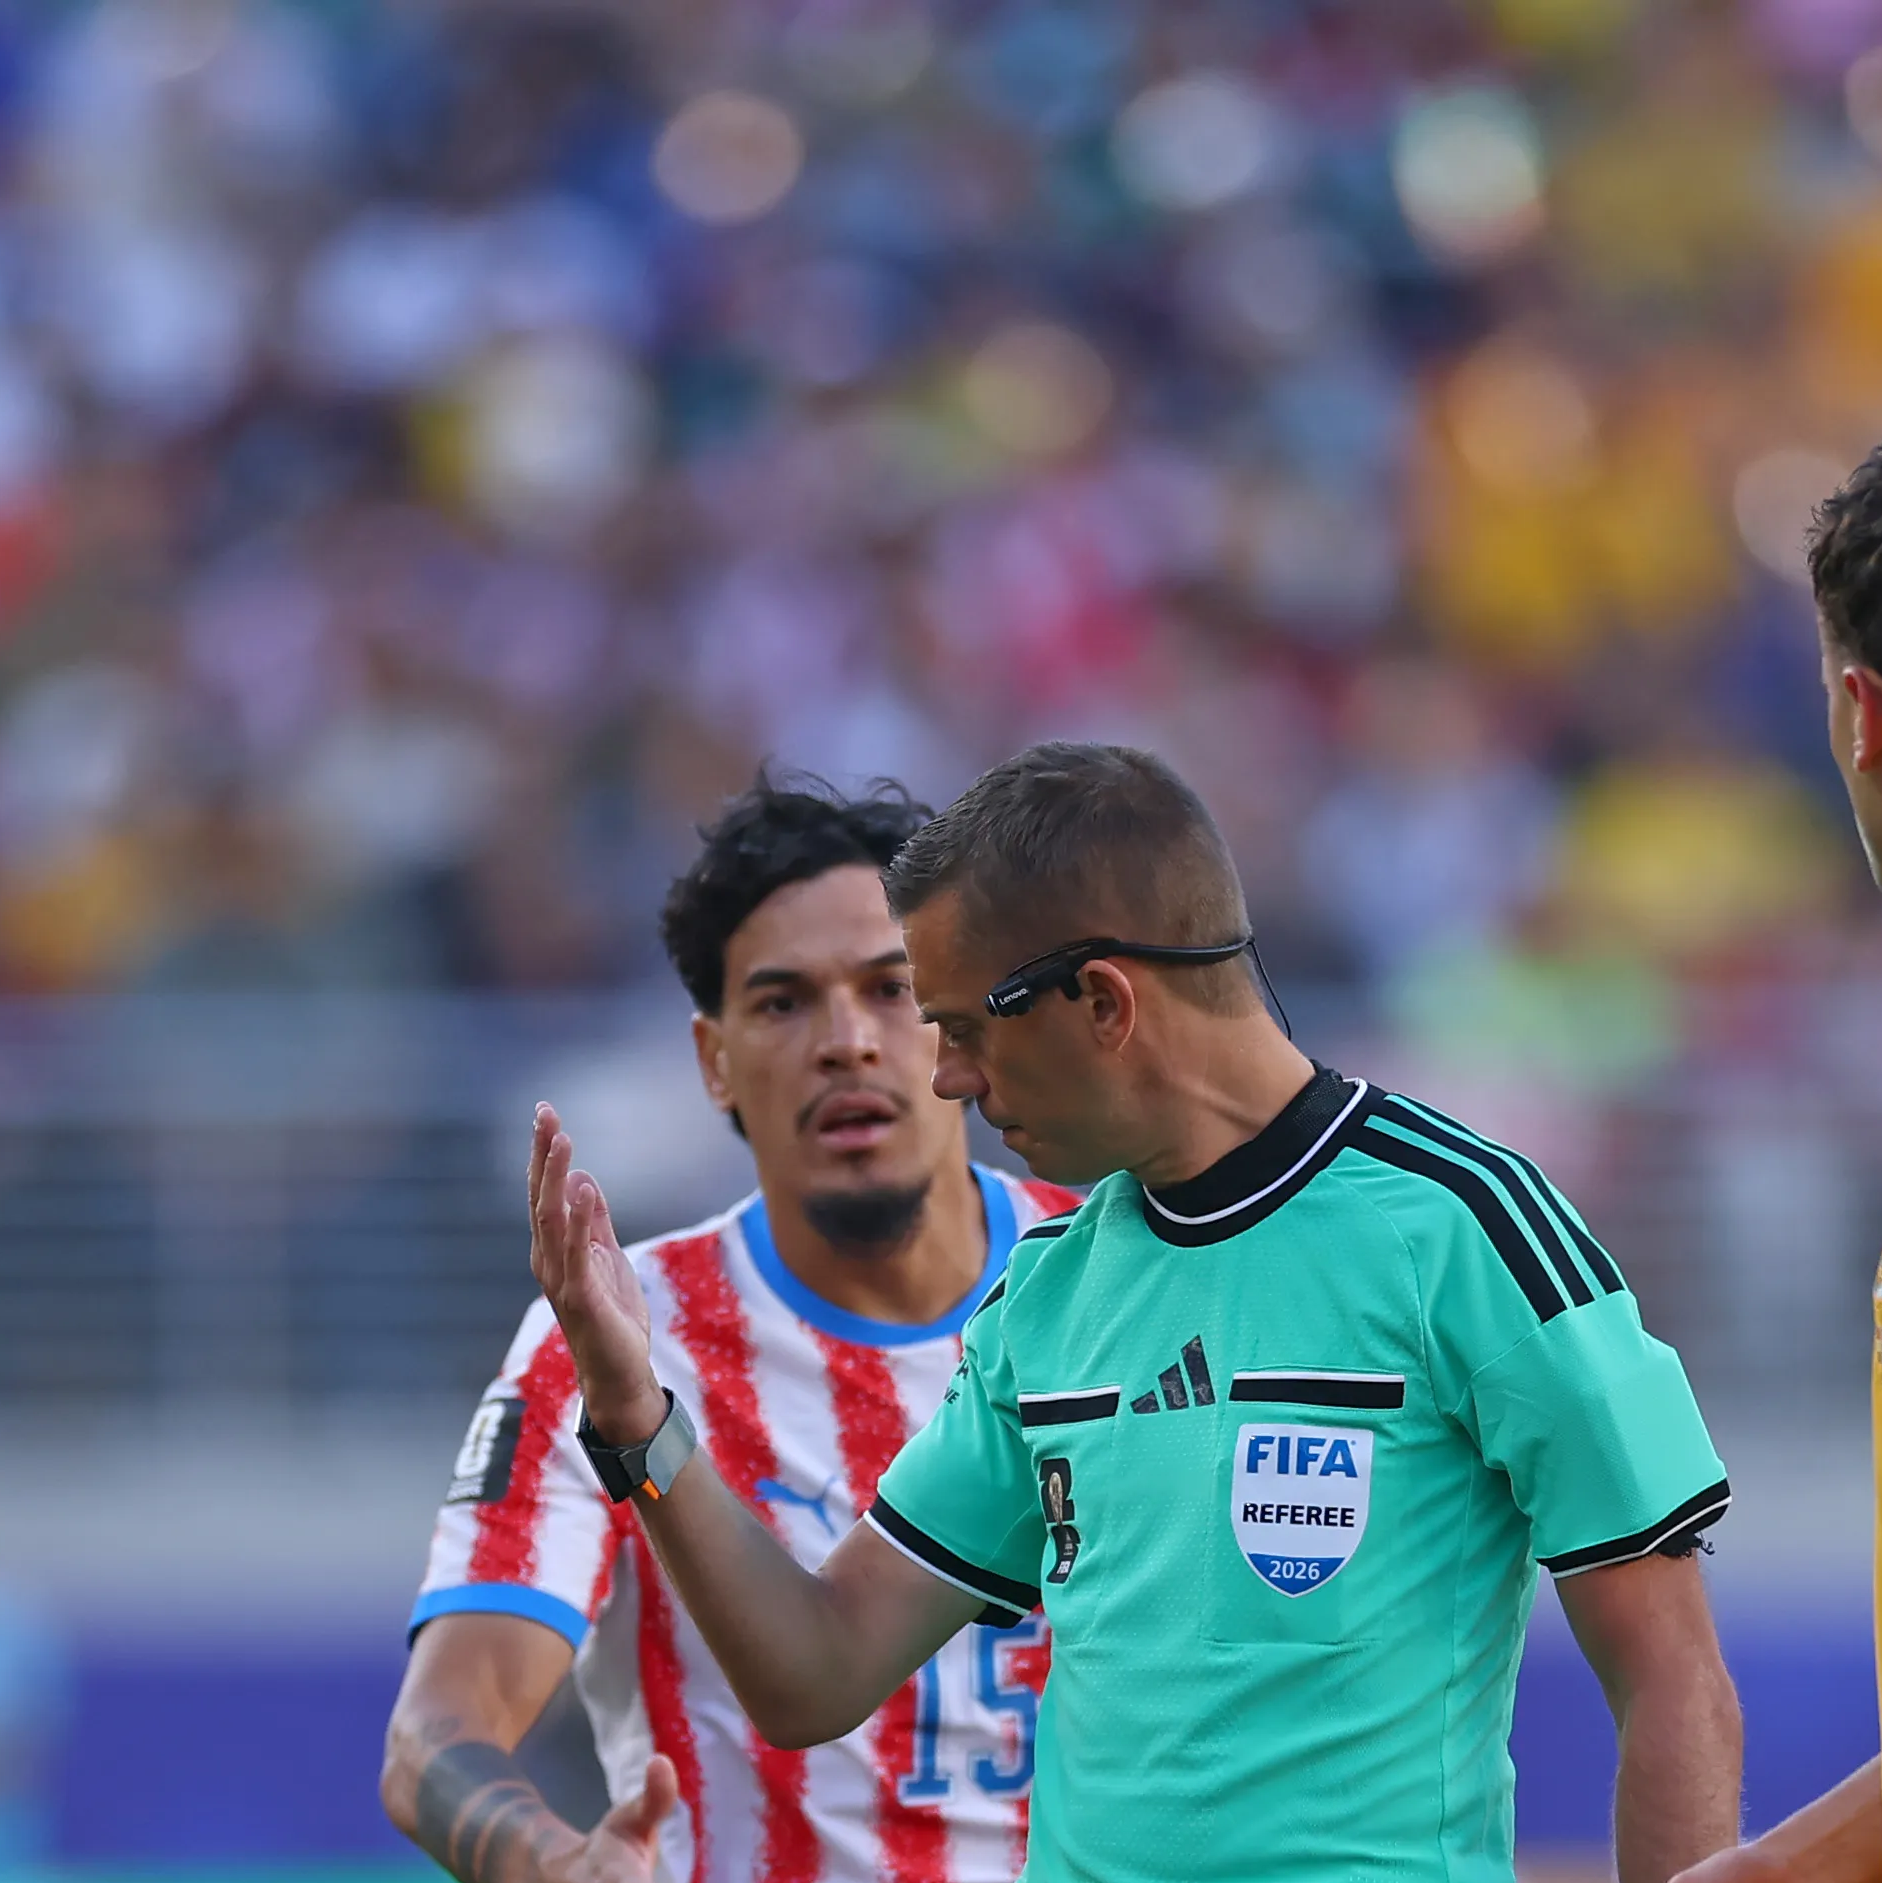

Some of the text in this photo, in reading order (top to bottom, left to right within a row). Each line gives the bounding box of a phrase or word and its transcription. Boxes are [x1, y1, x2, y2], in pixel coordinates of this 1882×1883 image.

[998, 988, 1028, 1005] Lenovo
[1246, 1435, 1358, 1478] FIFA
[1242, 1502, 1355, 1528] REFEREE
[1269, 1560, 1321, 1580] 2026
[898, 1615, 1045, 1808] 15
